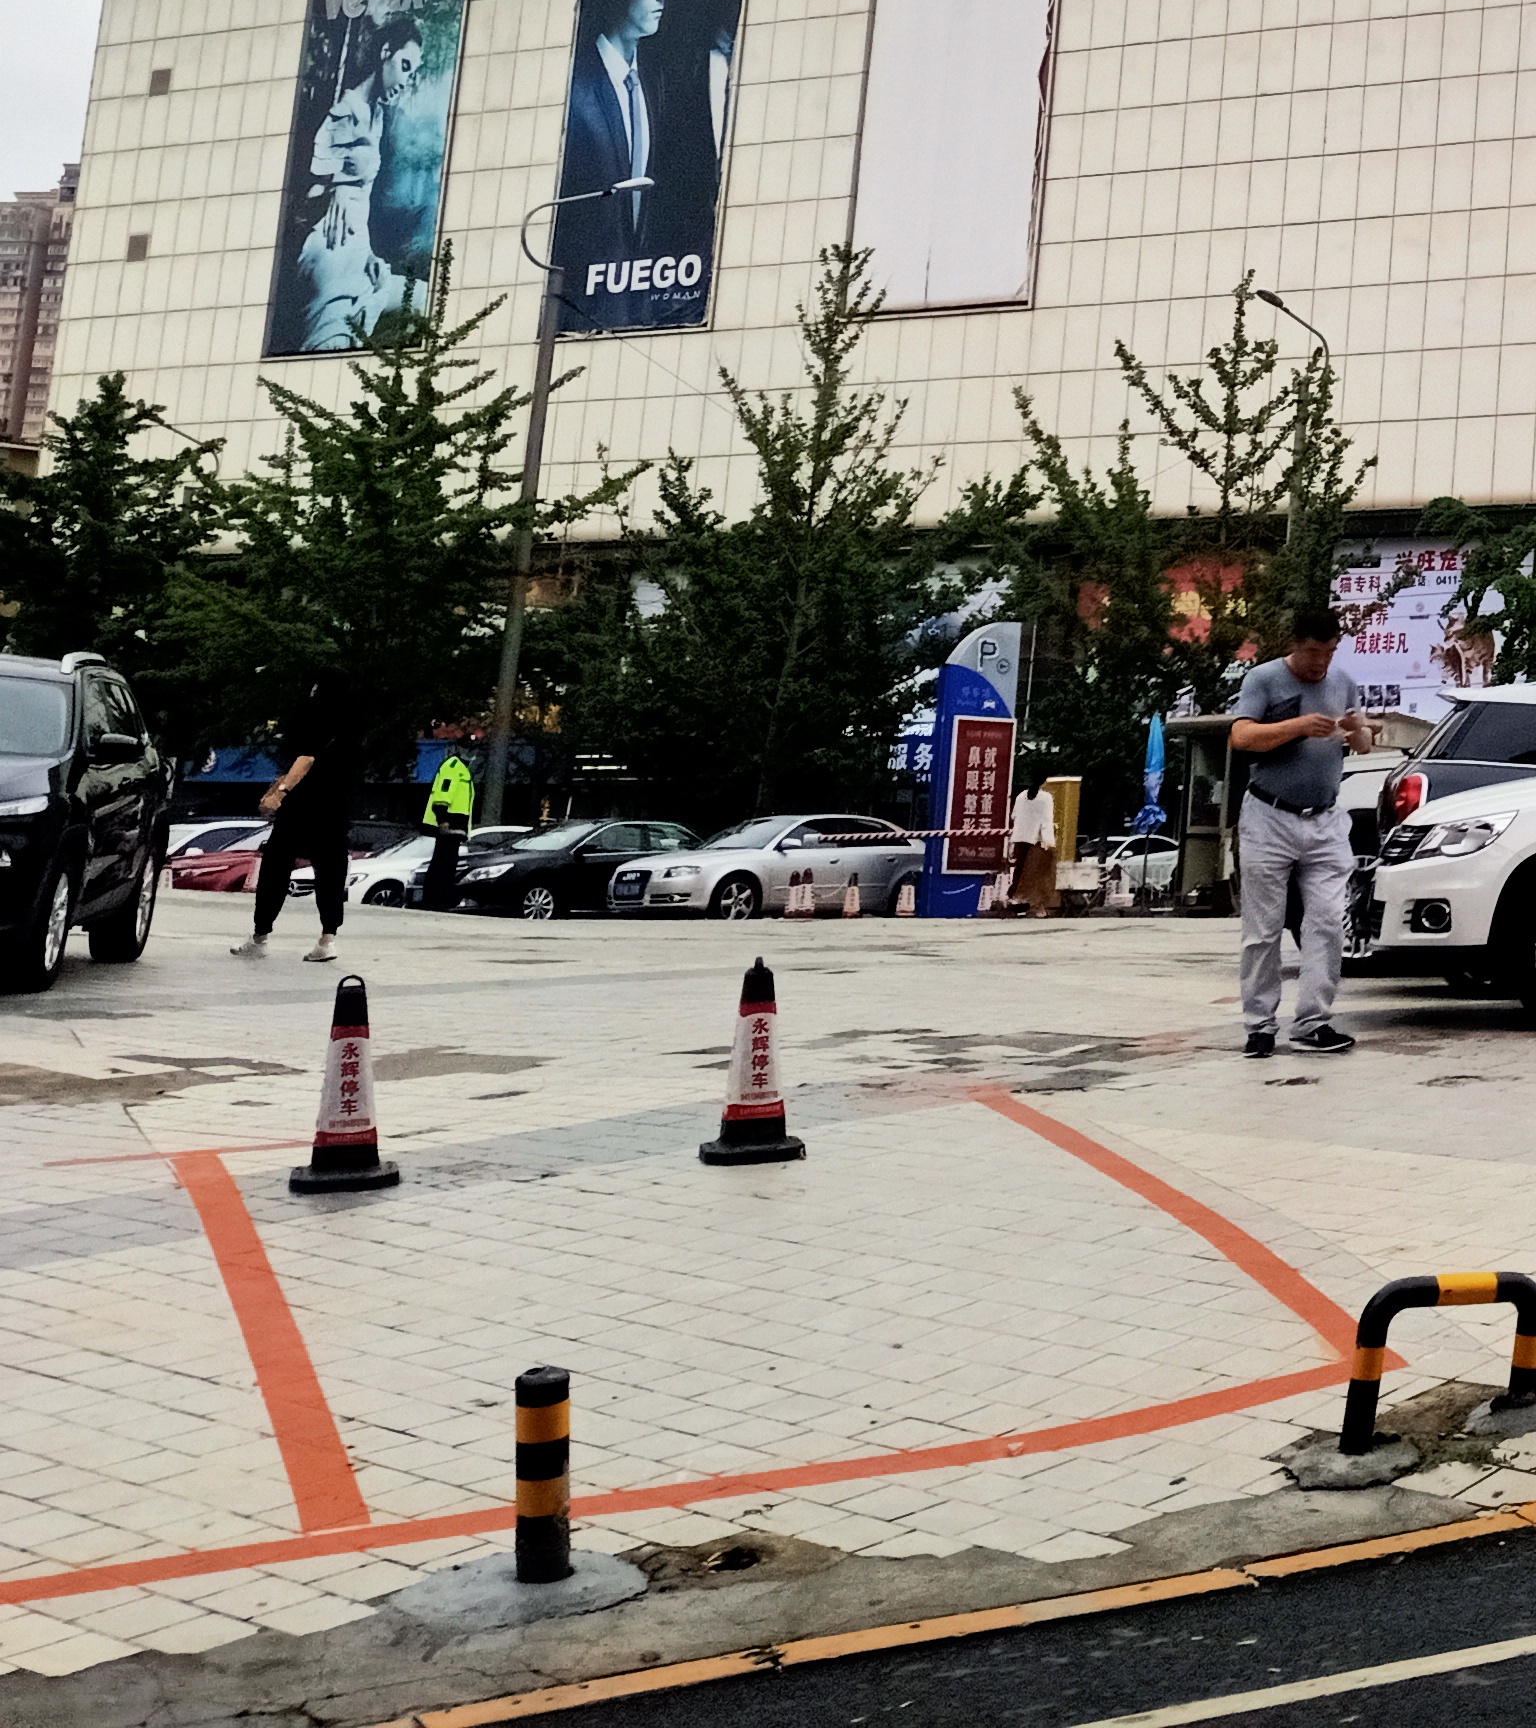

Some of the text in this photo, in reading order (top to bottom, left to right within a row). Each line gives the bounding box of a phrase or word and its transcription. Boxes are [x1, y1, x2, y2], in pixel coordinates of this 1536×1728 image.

[585, 253, 702, 296] FUEGO
[650, 290, 701, 301] WOMAN
[979, 639, 998, 668] P
[1354, 632, 1409, 654] 成就非凡
[887, 740, 934, 771] 服务
[751, 1017, 770, 1089] 永辉停车
[340, 1042, 360, 1116] 永辉停车
